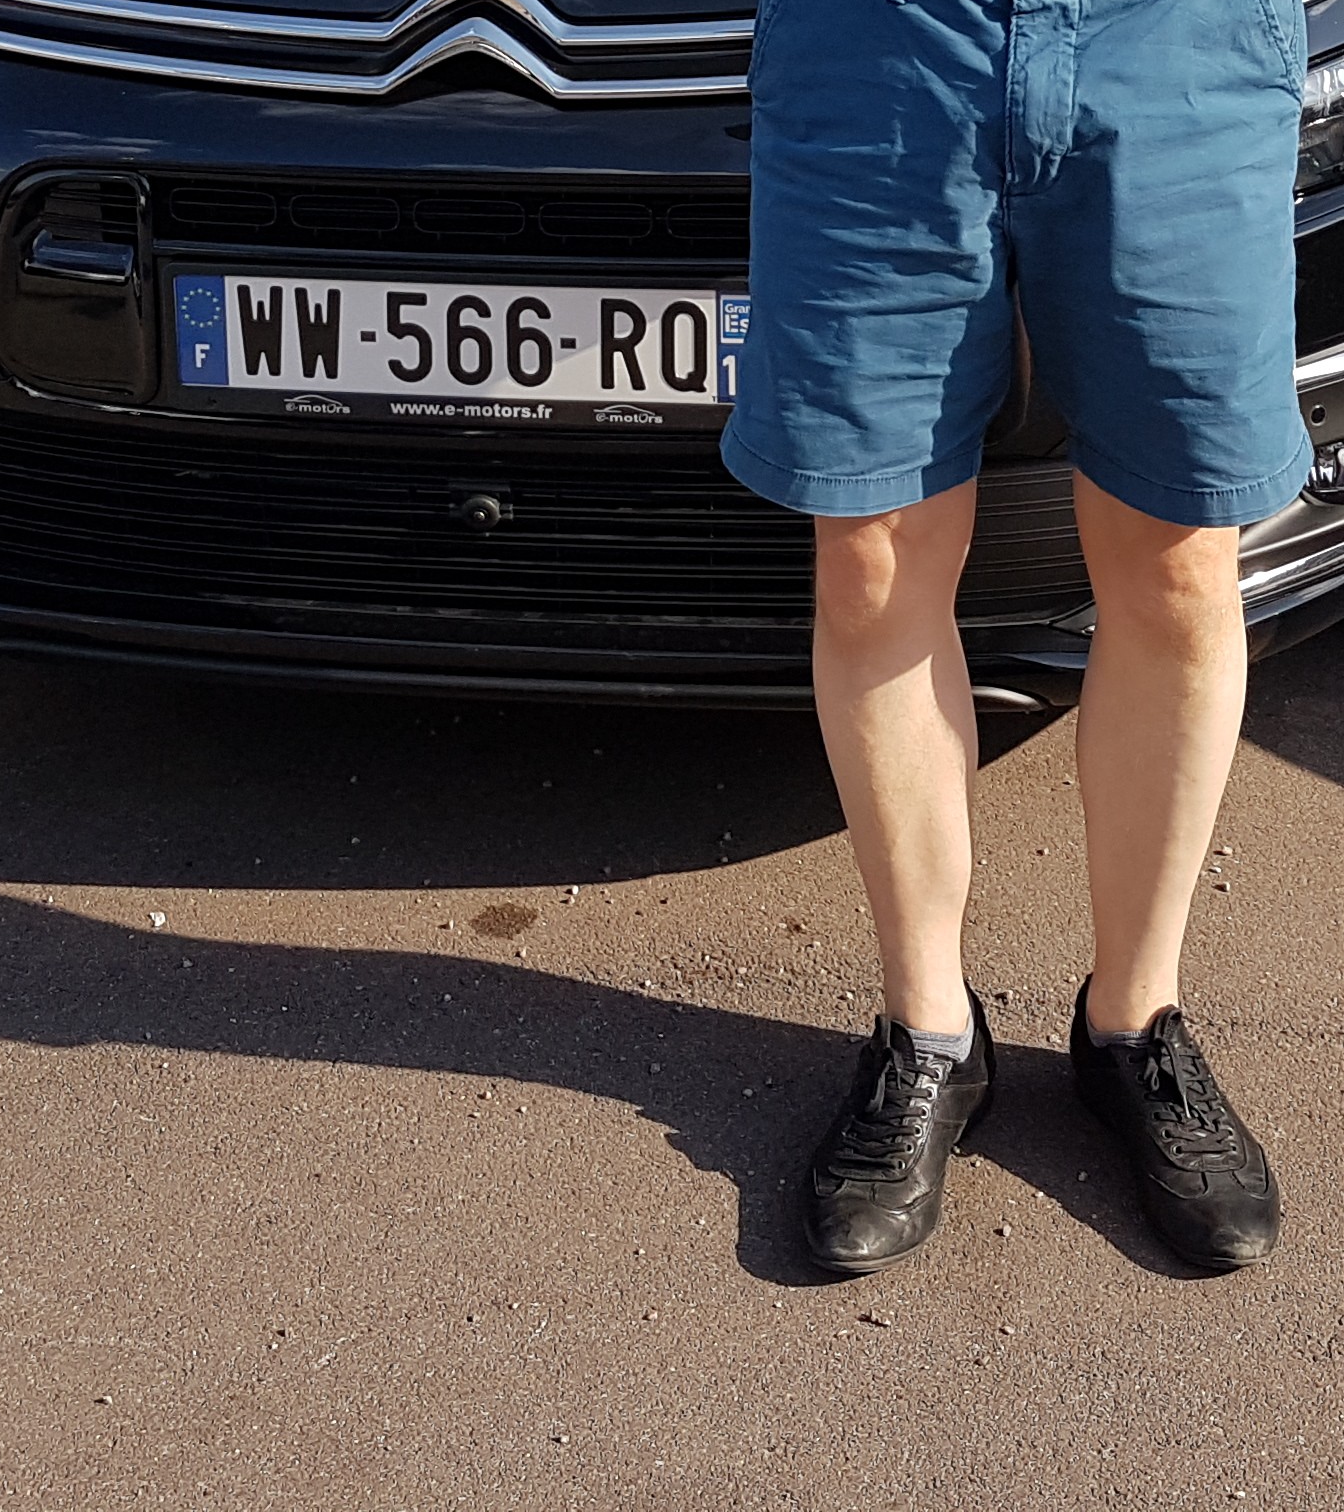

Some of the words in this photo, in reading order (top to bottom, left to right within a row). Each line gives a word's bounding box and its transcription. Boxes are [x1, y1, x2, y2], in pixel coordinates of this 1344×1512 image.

[236, 284, 708, 393] WW-566-RQ
[194, 343, 211, 369] F
[390, 402, 553, 419] www.e-motors.fr
